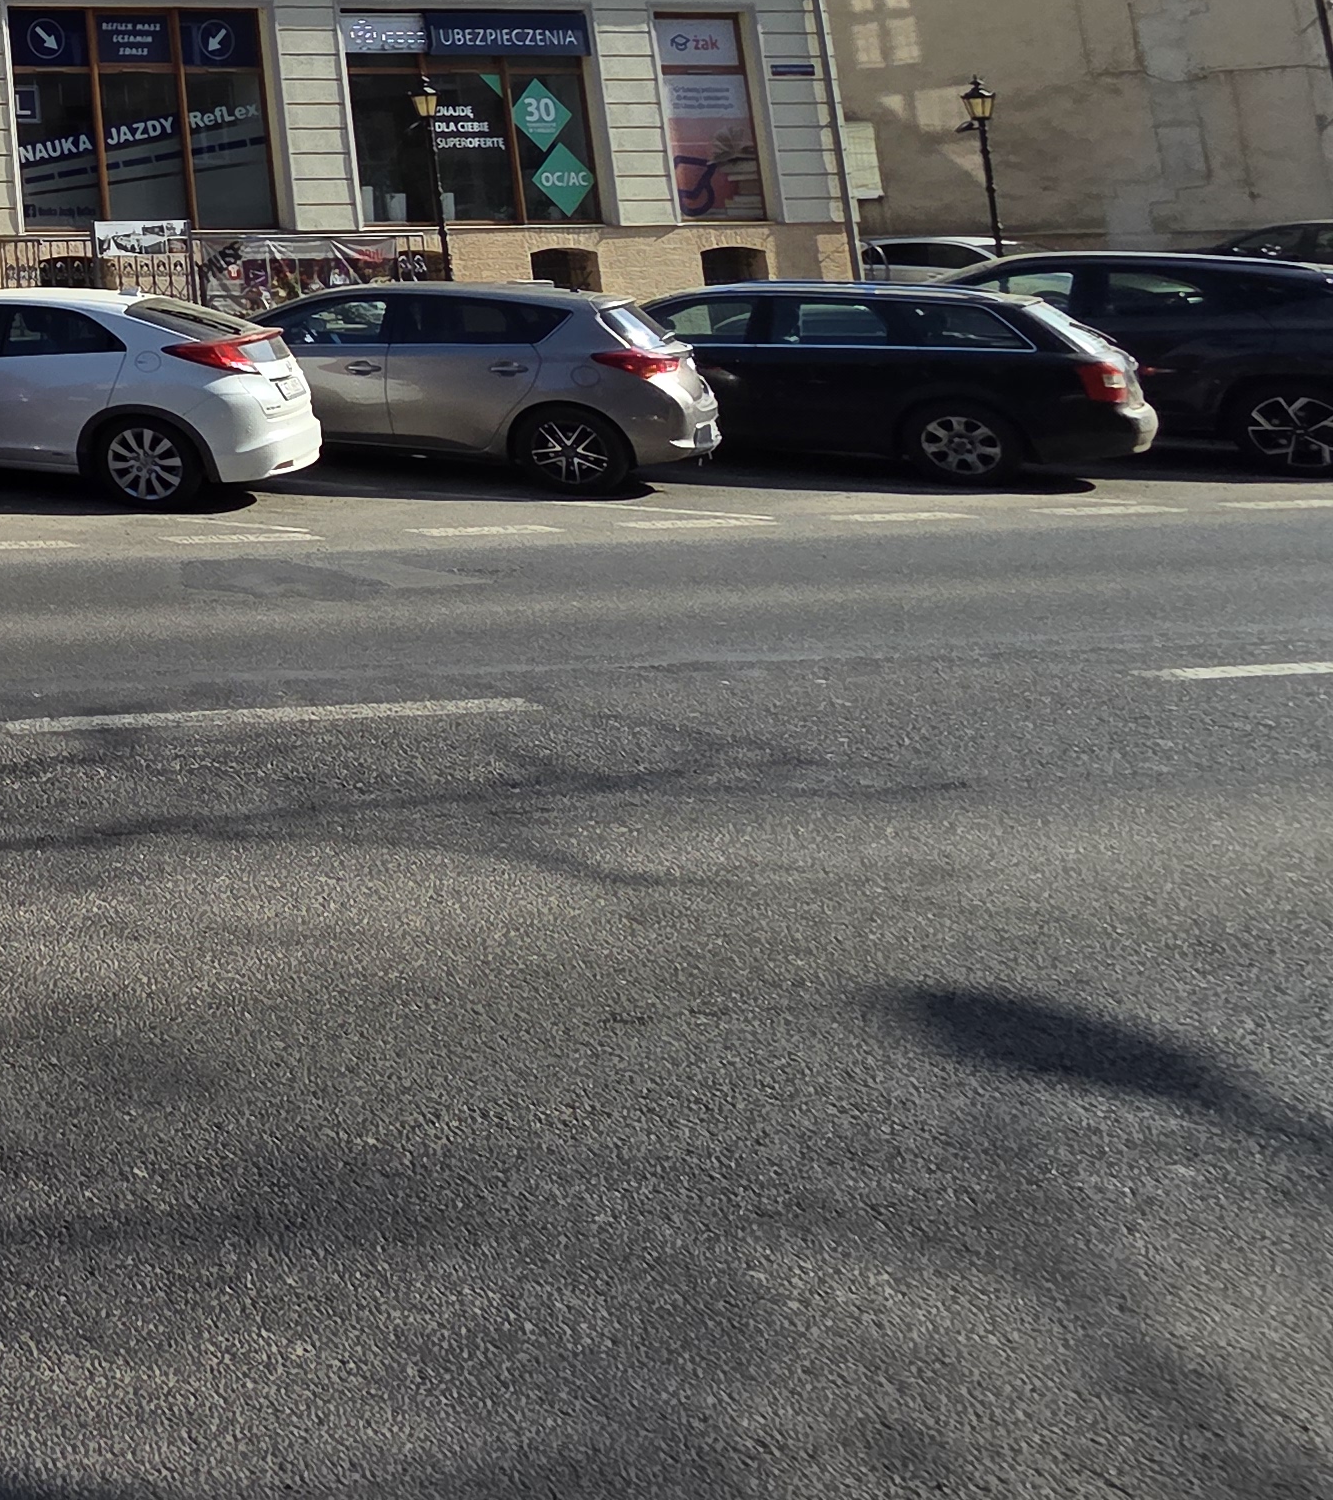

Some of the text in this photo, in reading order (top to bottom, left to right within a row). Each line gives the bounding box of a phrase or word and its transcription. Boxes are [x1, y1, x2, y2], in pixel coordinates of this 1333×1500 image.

[439, 28, 578, 46] UBEZPIECZENIA
[692, 34, 720, 50] żak
[523, 97, 556, 122] 30
[435, 121, 490, 132] DLA CIEBIE
[18, 133, 94, 164] NAUKA
[107, 116, 174, 146] JAZDY
[436, 137, 505, 150] SUPEROFERTĘ
[541, 171, 589, 187] OC/AC
